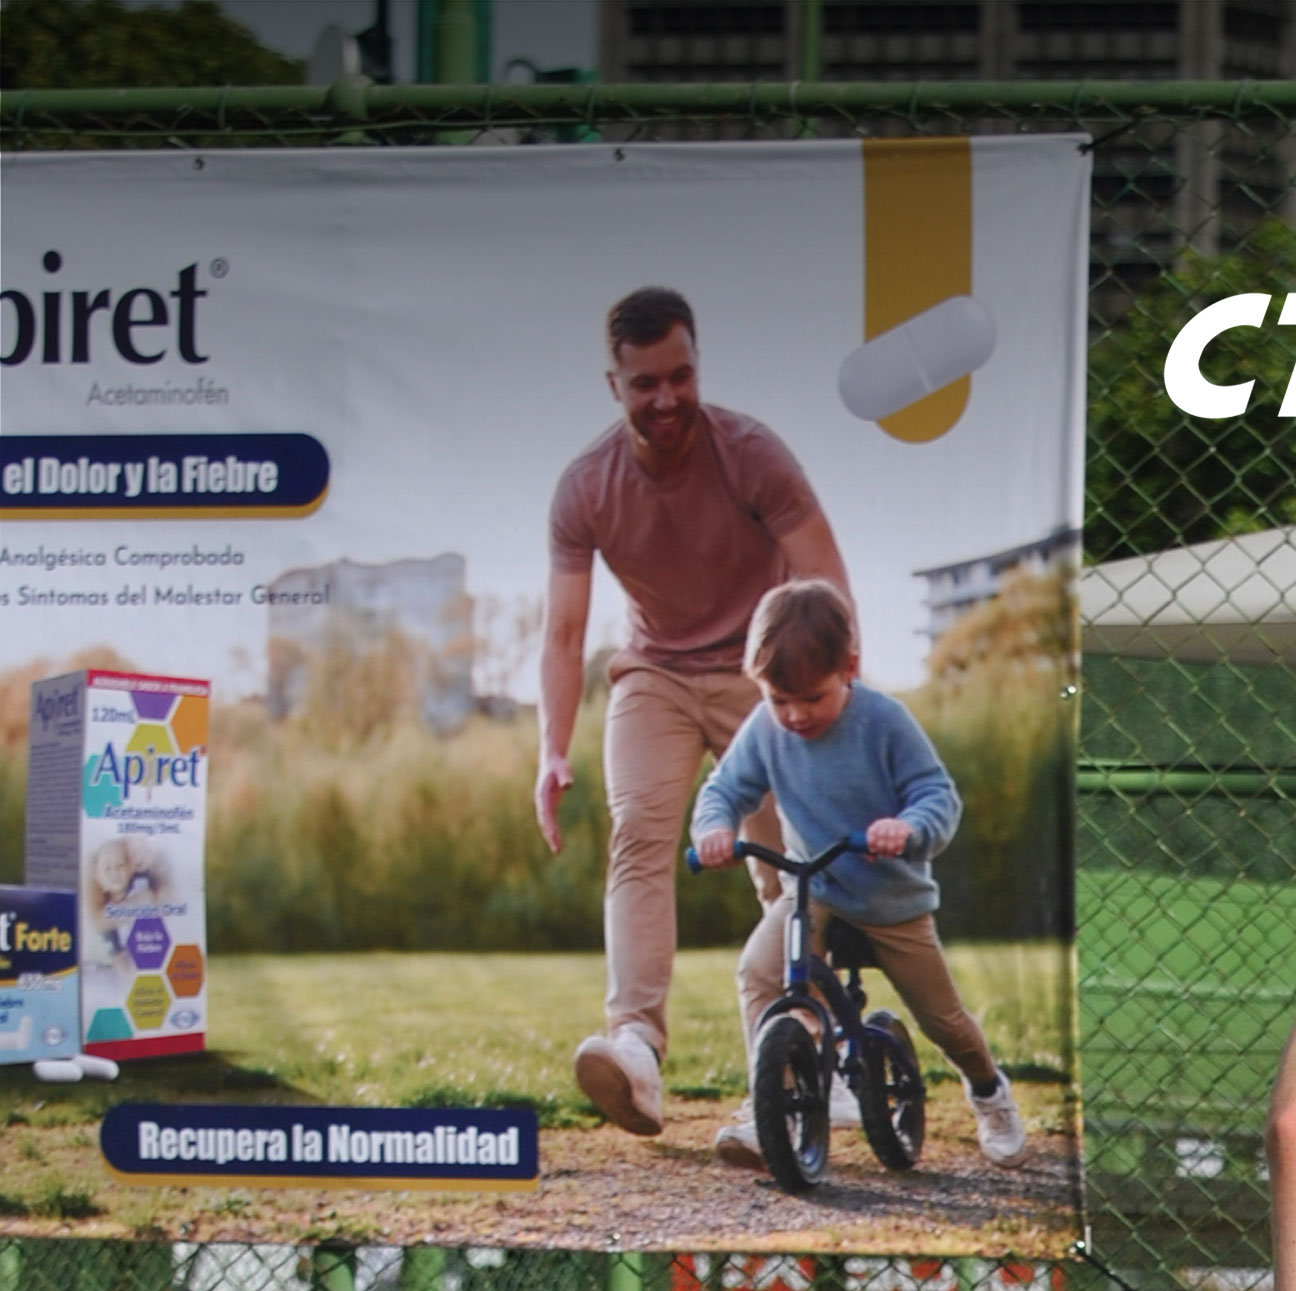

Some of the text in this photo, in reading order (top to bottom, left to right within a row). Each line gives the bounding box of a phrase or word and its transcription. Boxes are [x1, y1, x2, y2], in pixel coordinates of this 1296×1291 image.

[87, 378, 229, 405] Acetaminofén
[3, 455, 279, 497] el Dolor y la Fiebre
[0, 544, 245, 571] Analgésica Comprobada
[116, 585, 147, 606] del
[154, 585, 243, 605] Malestar
[250, 585, 330, 605] General
[94, 740, 200, 799] Apiret
[15, 921, 72, 953] Forte
[139, 1121, 520, 1165] Recupera la Normalidad
